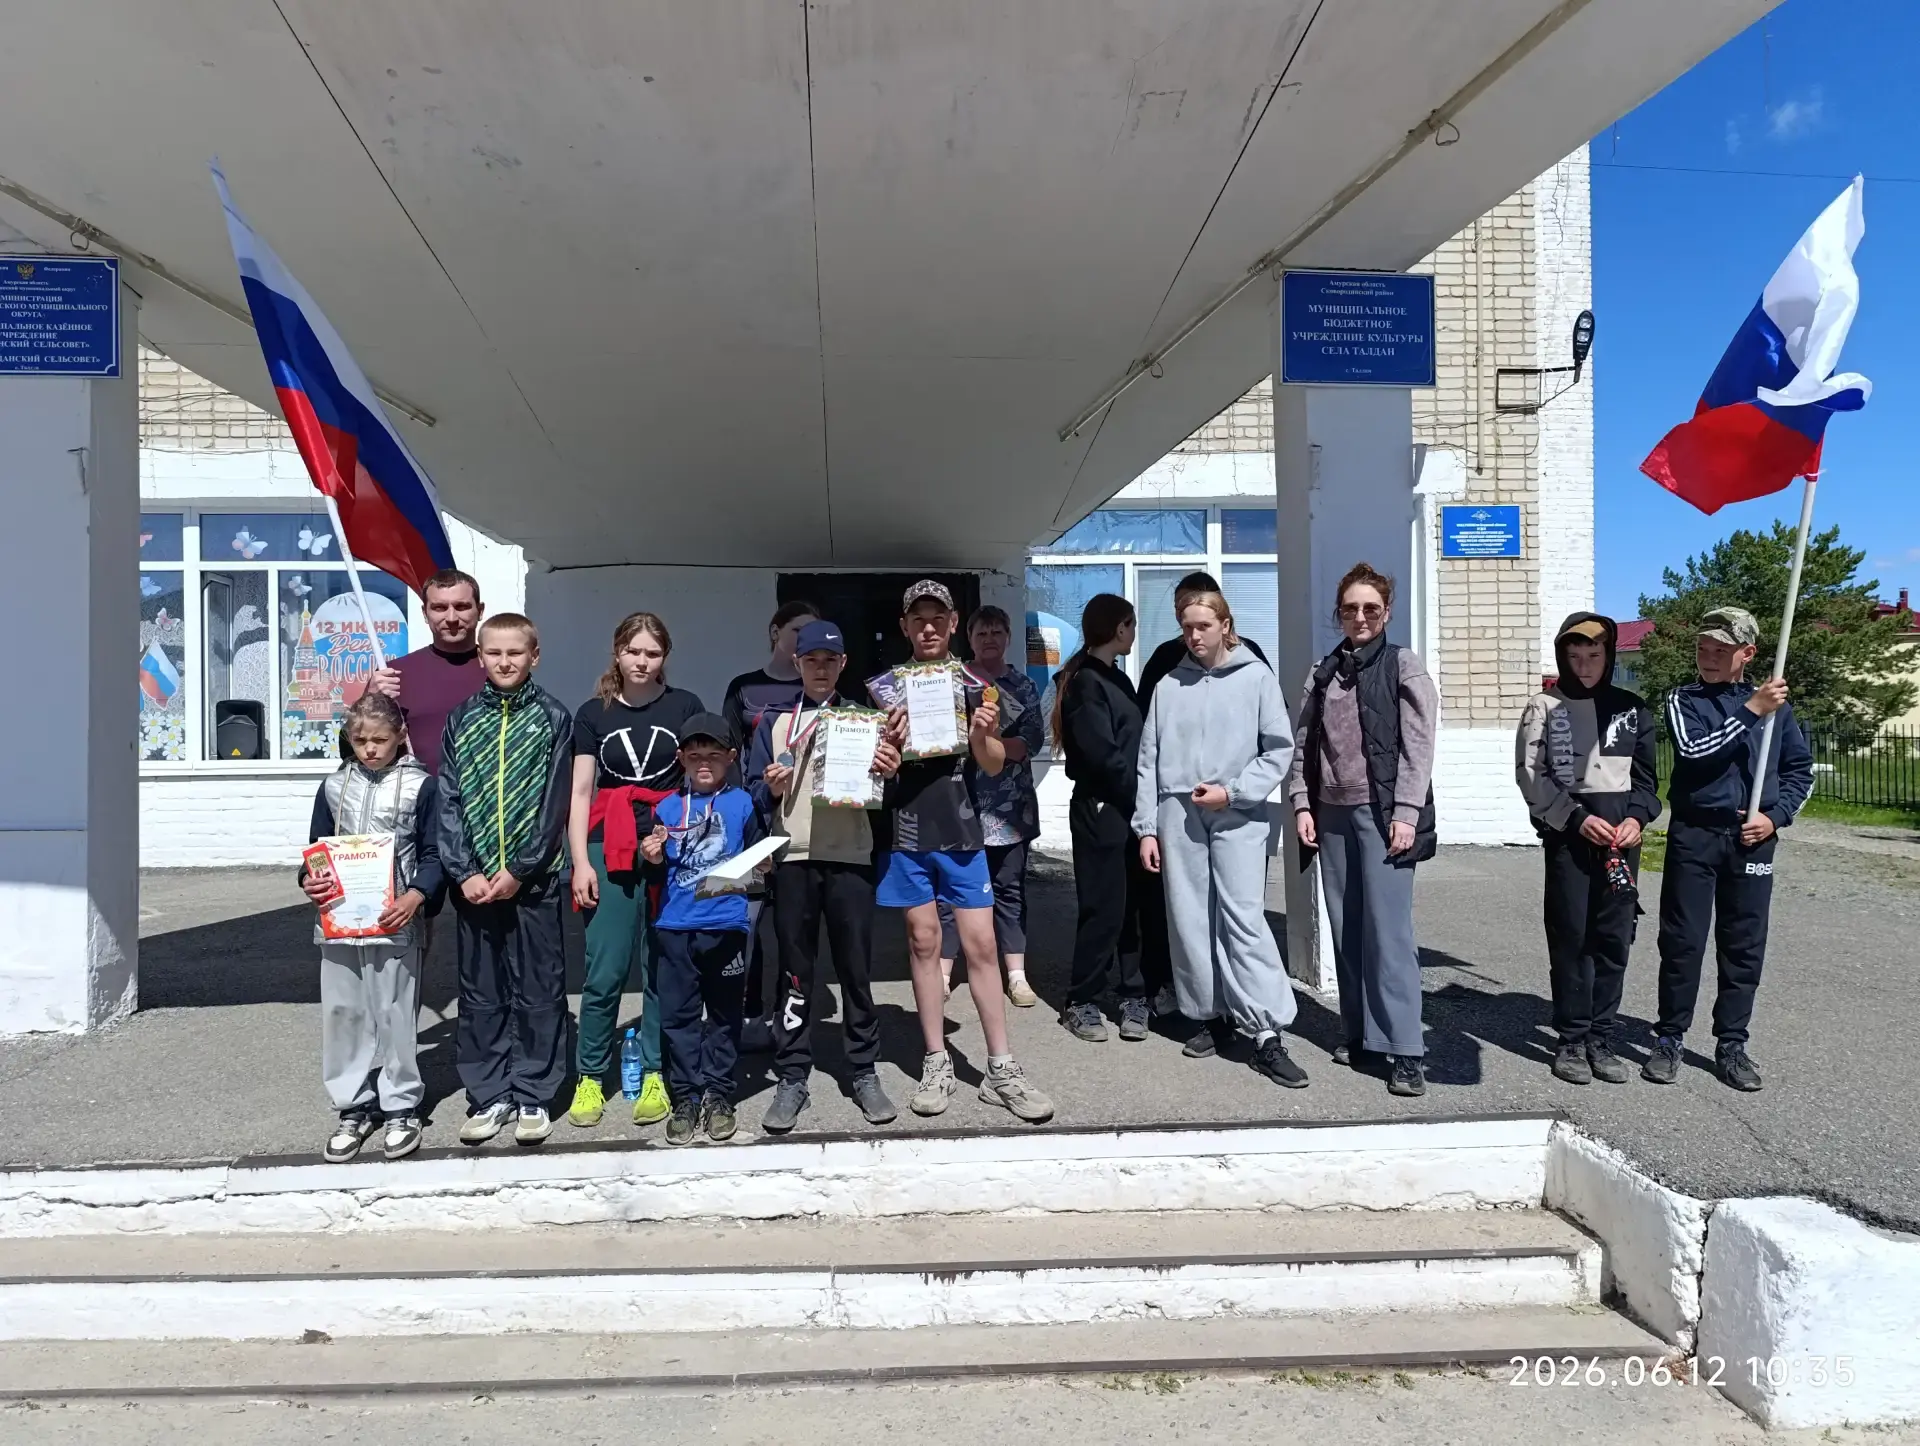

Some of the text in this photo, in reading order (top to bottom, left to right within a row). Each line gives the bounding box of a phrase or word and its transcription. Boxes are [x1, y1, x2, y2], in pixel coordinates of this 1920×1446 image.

[1330, 279, 1360, 288] Амурская
[1374, 289, 1394, 297] район
[28, 303, 109, 311] МУНИЦИПАЛЬНОГО
[1308, 304, 1408, 316] МУНИЦИПАЛЬНОЕ
[46, 322, 93, 331] КАЗЁННОЕ
[1323, 318, 1393, 329] БЮДЖЕТНОЕ
[1292, 331, 1424, 343] УЧРЕЖДЕНИЕ КУЛЬТУРЫ
[1321, 346, 1395, 357] СЕЛА ТАЛДАН
[315, 620, 335, 634] 12
[911, 678, 947, 689] Грамота
[834, 724, 871, 734] Грамота
[898, 808, 919, 852] NIKE
[333, 851, 378, 861] ГРАМОТА
